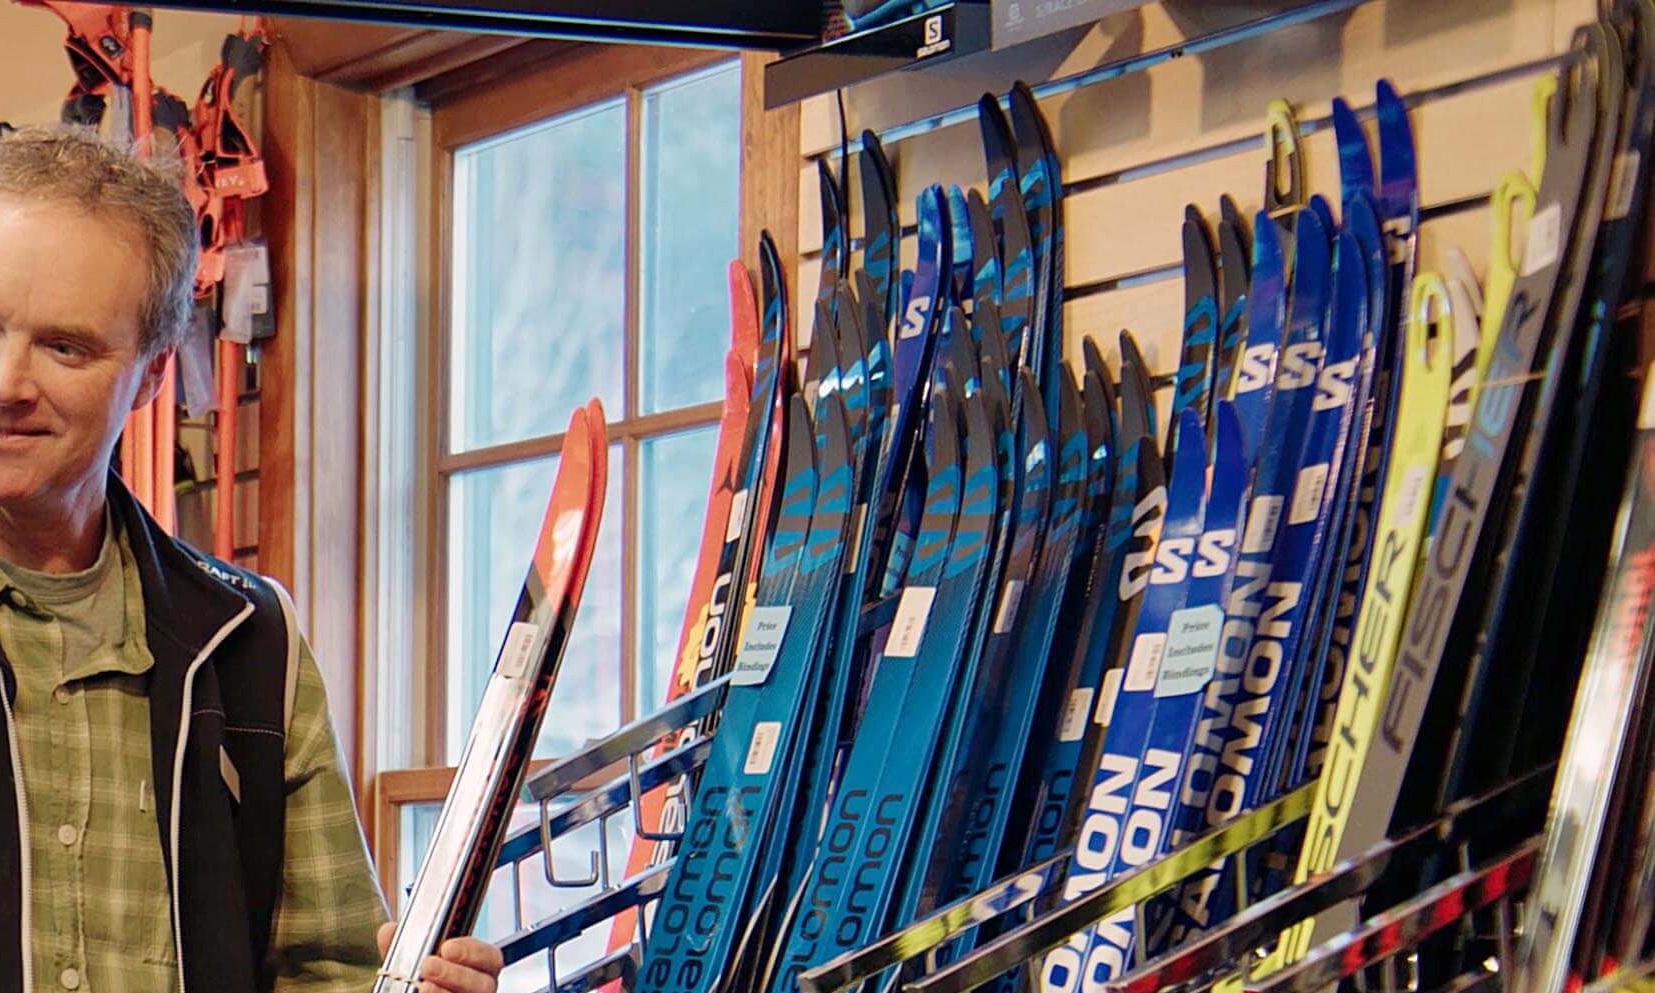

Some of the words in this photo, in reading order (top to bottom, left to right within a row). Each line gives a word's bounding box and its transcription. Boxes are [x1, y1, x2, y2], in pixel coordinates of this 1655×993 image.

[900, 295, 930, 339] S
[1382, 289, 1541, 753] FISCHER
[1149, 538, 1195, 584] S
[1193, 529, 1236, 577] S
[757, 621, 777, 632] Price
[1181, 622, 1210, 634] Price
[745, 641, 776, 651] Includes
[1167, 642, 1214, 658] Includes
[1161, 664, 1210, 681] Bindings
